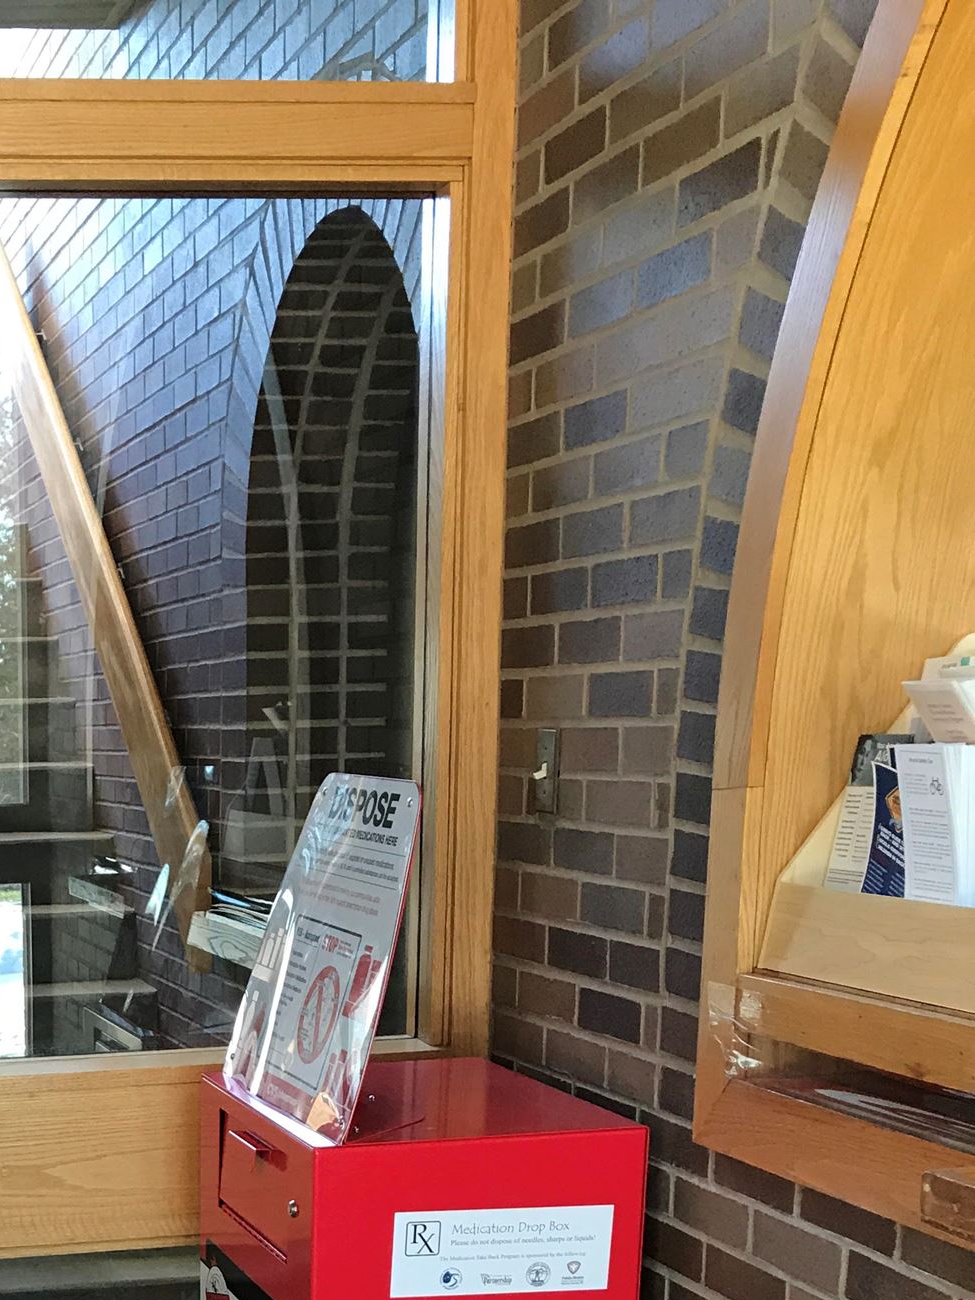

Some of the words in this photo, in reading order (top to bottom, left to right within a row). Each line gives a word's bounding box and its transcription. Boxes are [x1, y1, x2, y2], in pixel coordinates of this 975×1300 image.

[452, 1223, 514, 1235] Medication
[519, 1221, 545, 1234] Drop
[549, 1221, 569, 1231] Box
